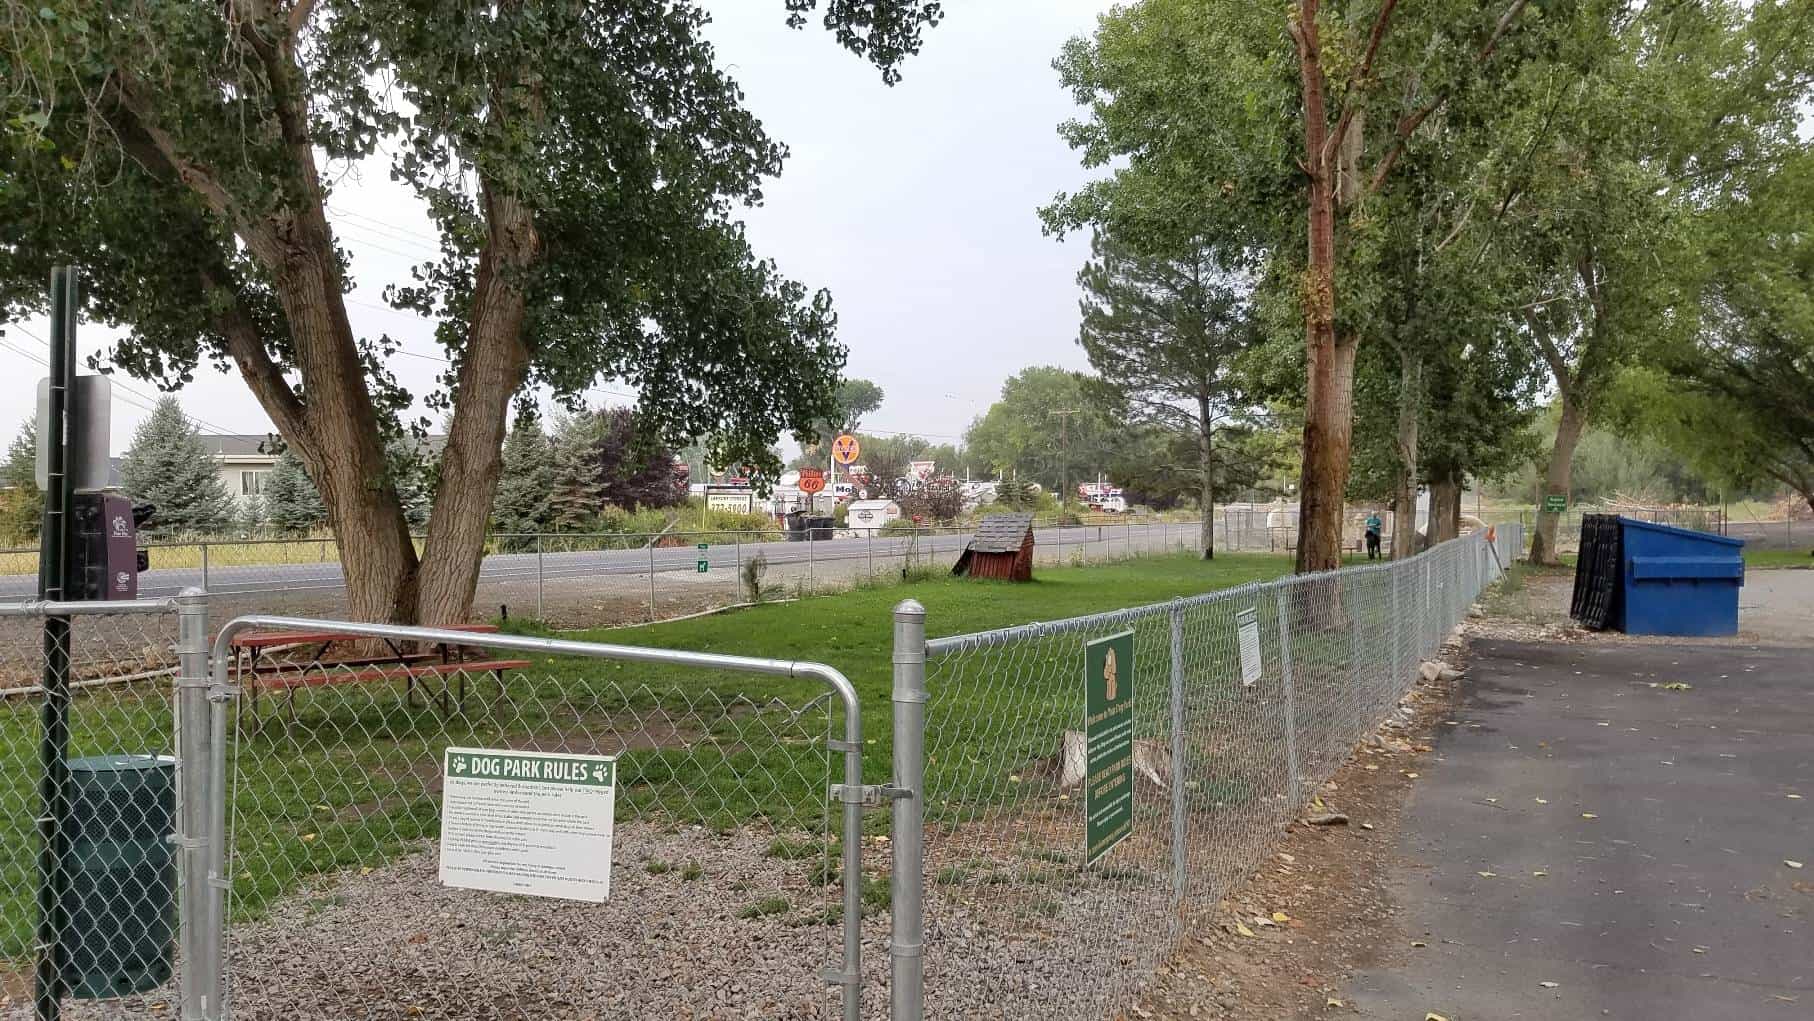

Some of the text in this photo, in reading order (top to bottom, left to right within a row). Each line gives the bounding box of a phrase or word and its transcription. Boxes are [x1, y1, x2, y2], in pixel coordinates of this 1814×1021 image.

[804, 479, 819, 489] 66
[471, 758, 588, 781] DOG PARK RULES
